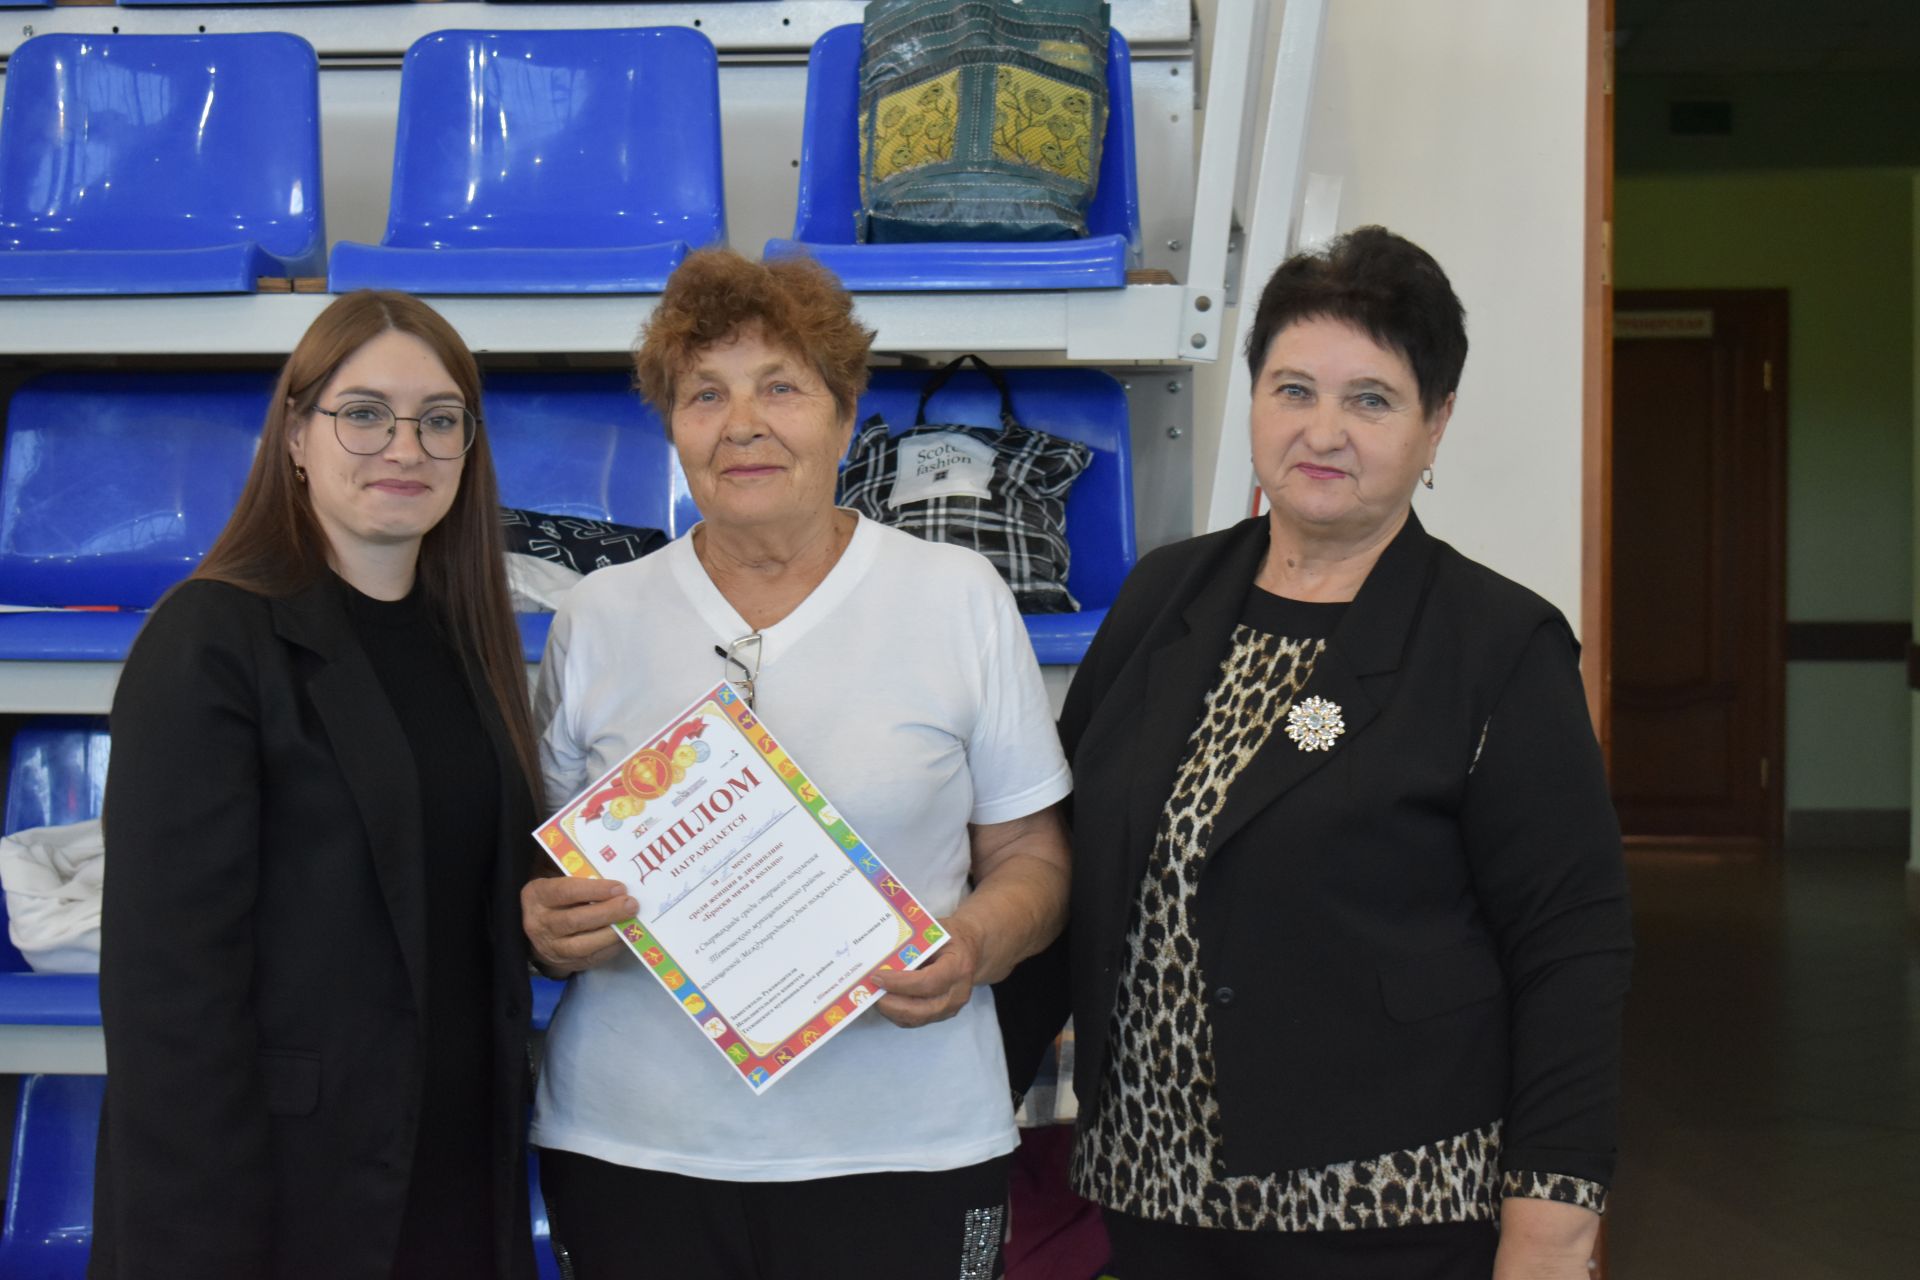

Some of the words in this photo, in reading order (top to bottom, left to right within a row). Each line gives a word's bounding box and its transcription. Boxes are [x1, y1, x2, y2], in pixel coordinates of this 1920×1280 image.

[917, 455, 972, 476] fashion
[629, 766, 763, 885] ДИПЛОМ
[669, 812, 748, 878] НАГРАЖДАЕТСЯ
